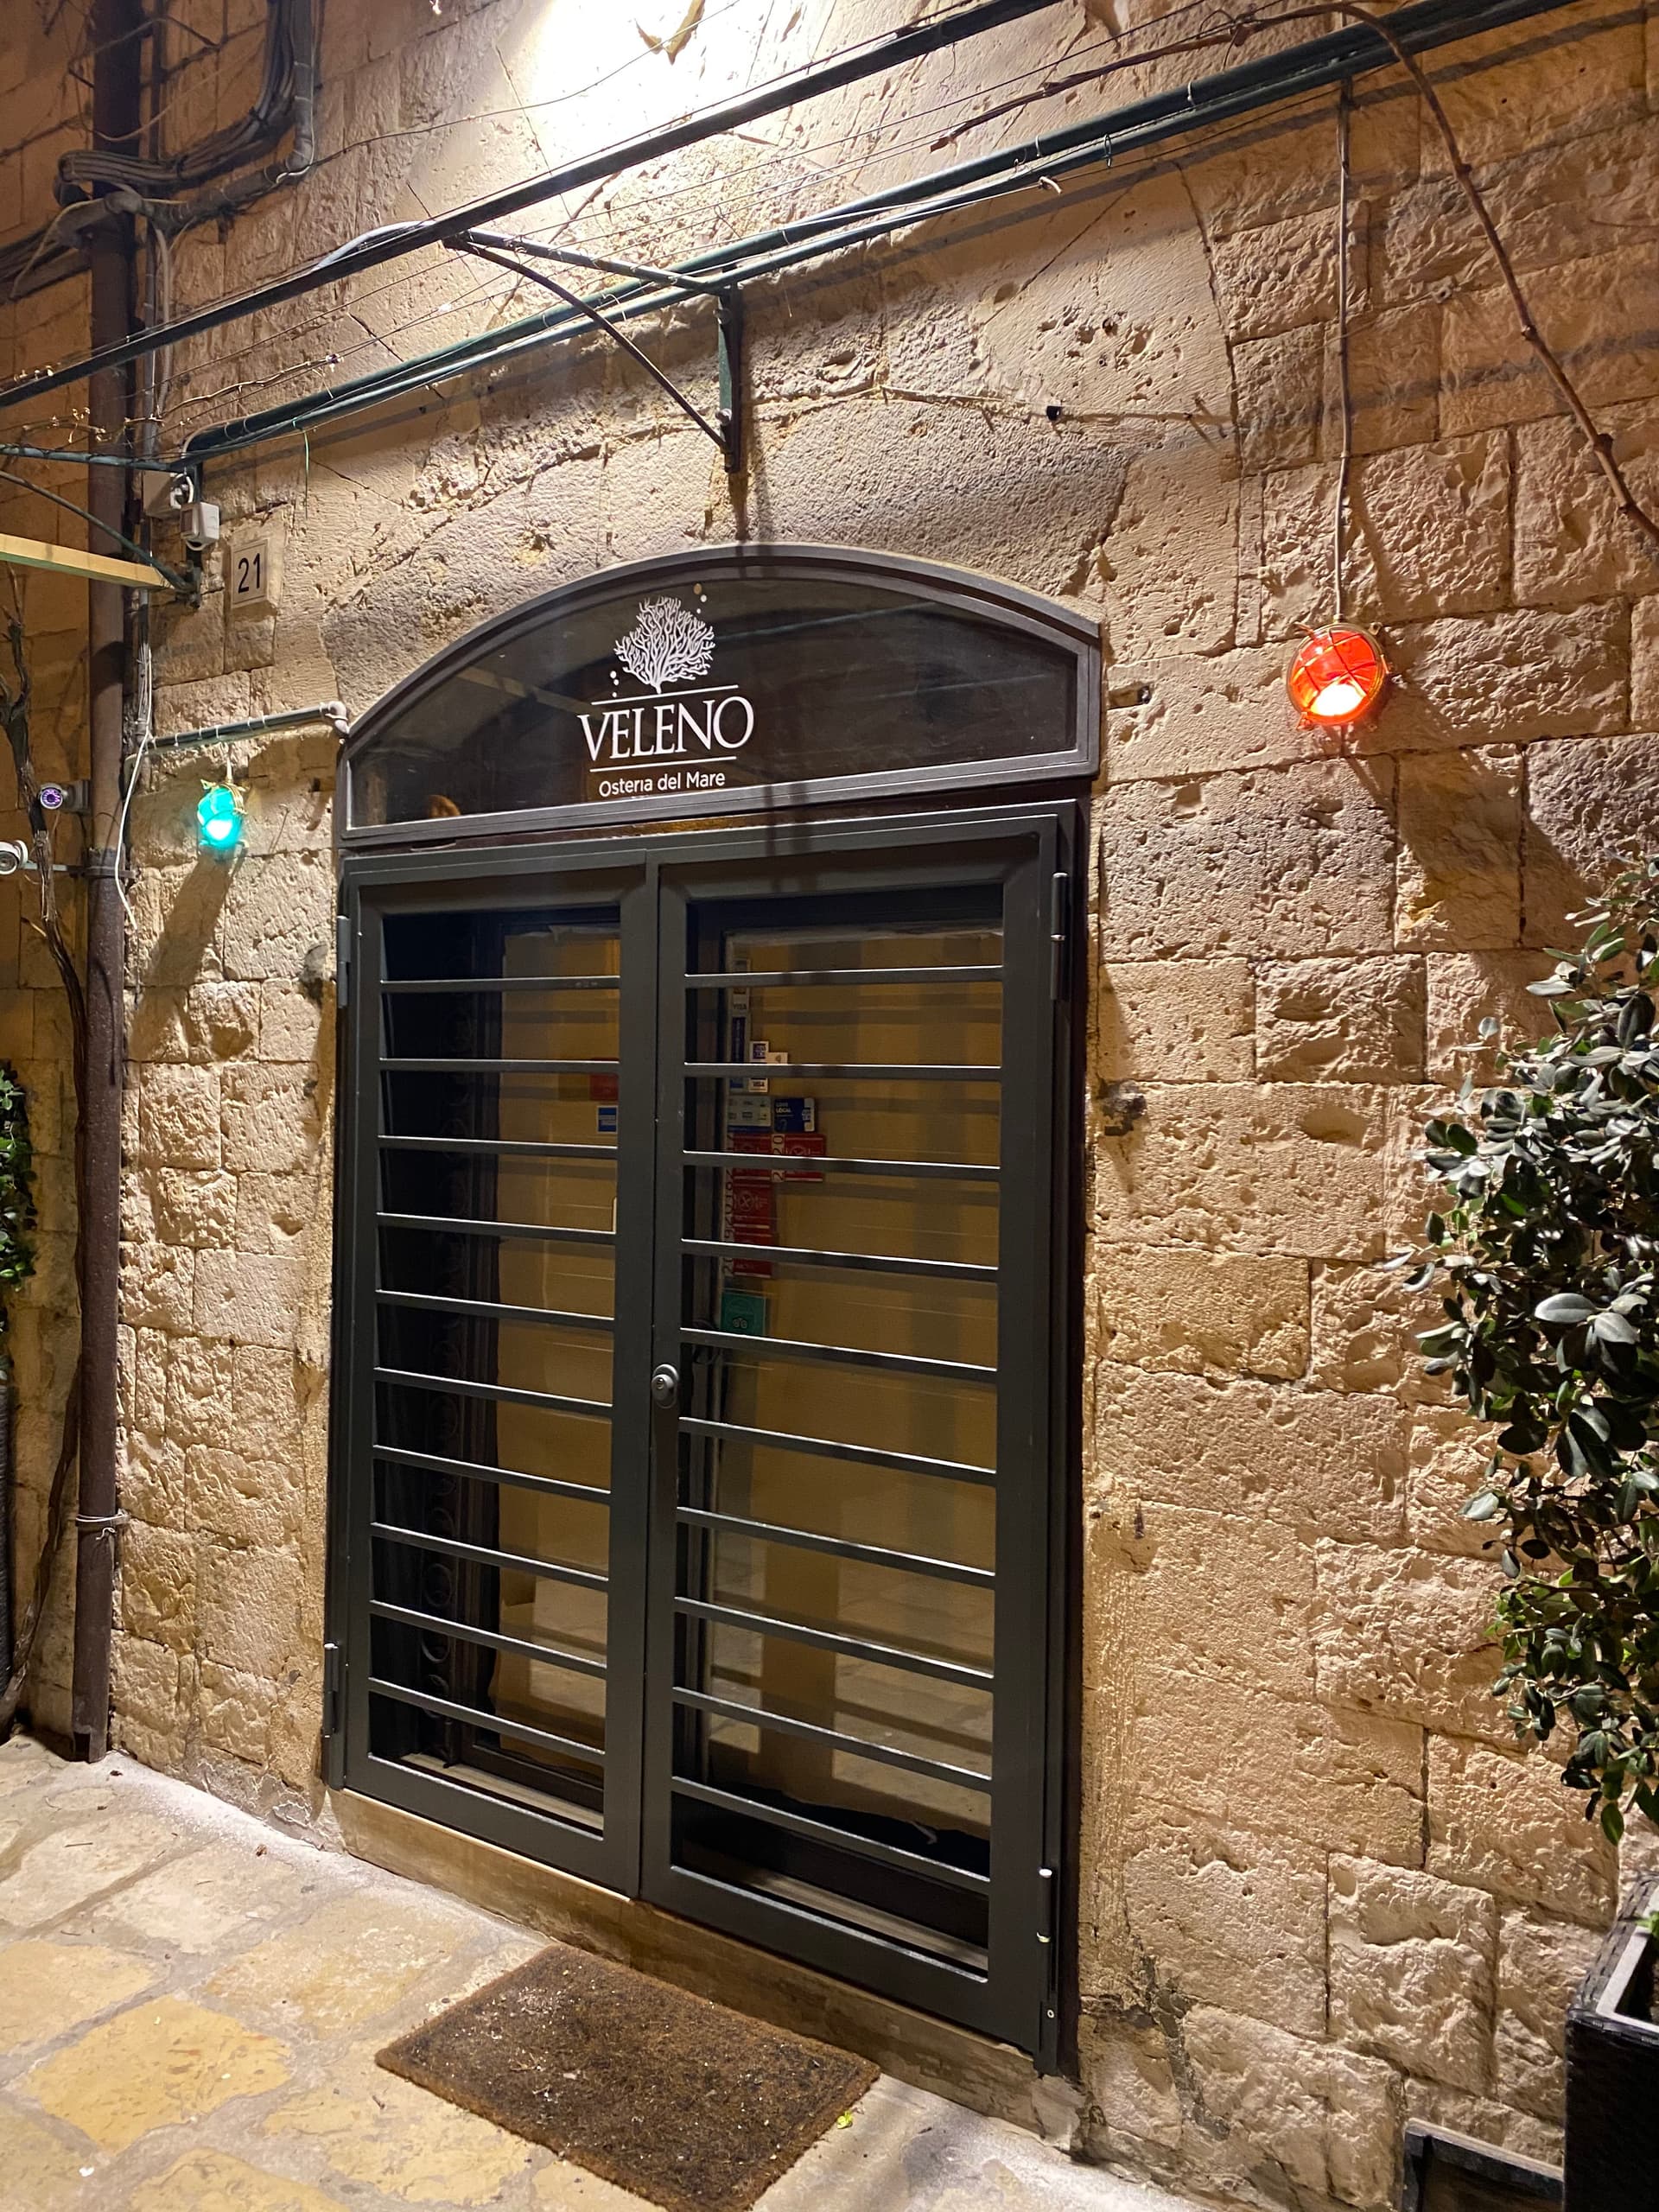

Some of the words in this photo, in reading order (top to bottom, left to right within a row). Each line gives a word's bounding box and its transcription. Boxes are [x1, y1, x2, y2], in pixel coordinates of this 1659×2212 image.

[238, 552, 261, 594] 21
[576, 696, 754, 762] VELENO
[599, 779, 653, 798] Osteria
[657, 772, 681, 791] del
[686, 771, 726, 788] Mare
